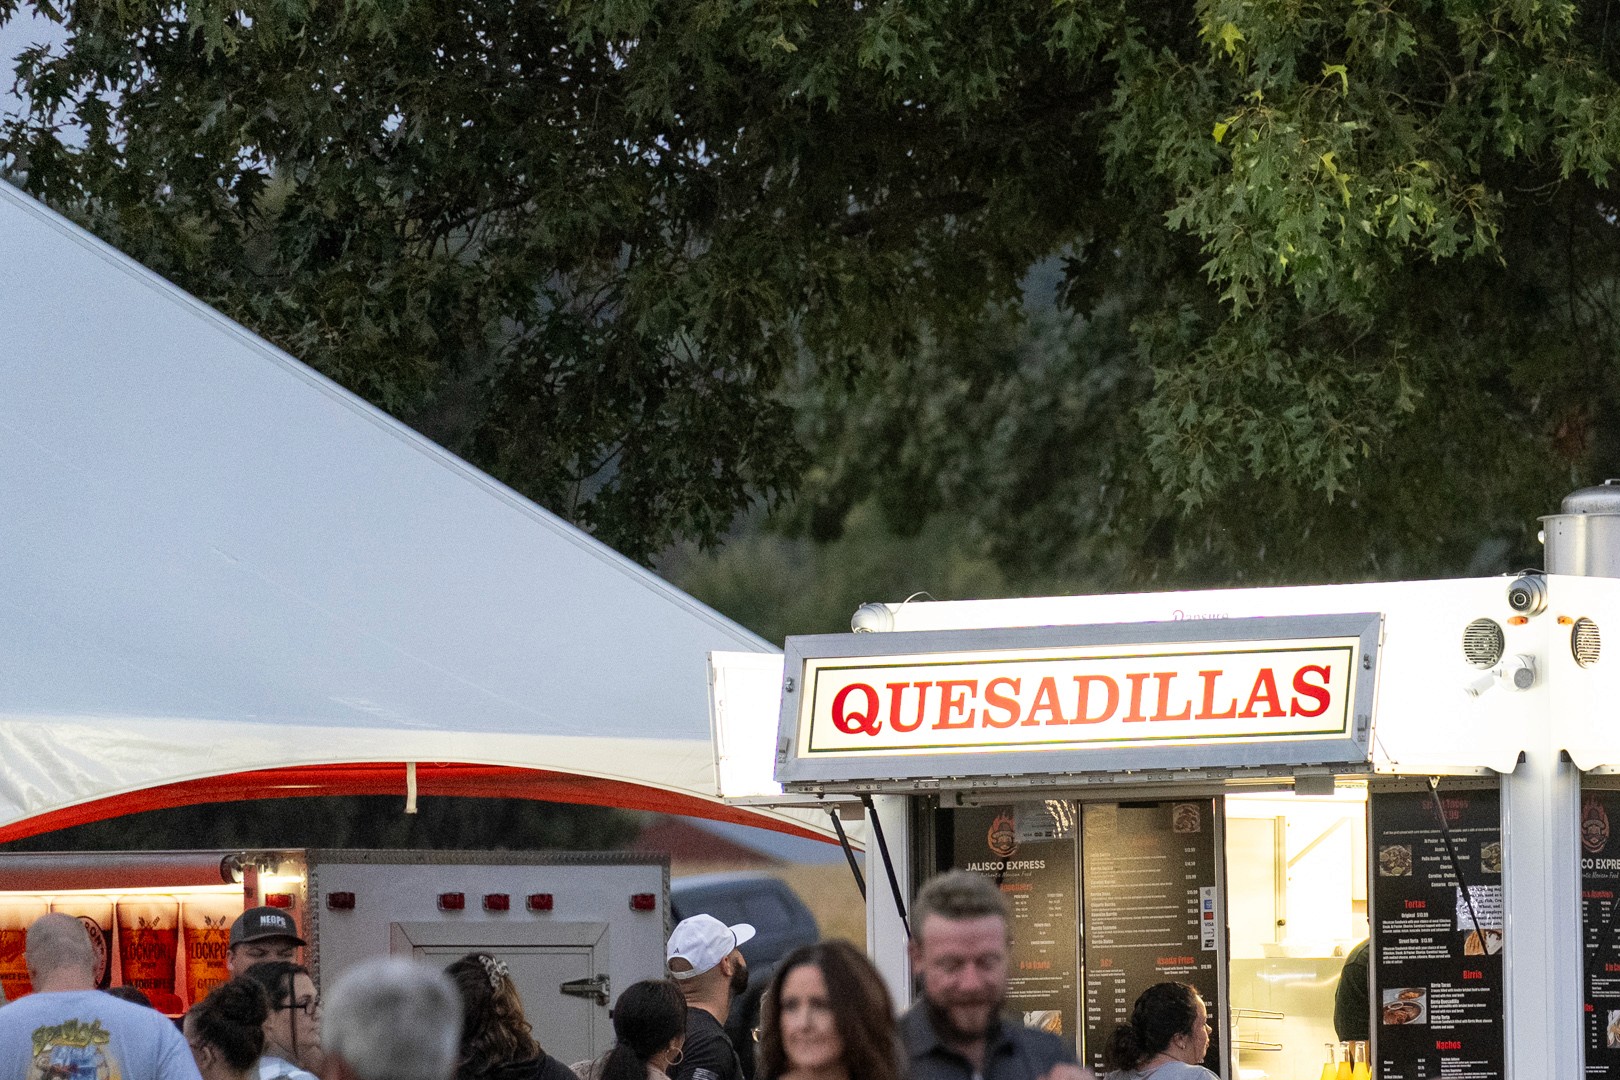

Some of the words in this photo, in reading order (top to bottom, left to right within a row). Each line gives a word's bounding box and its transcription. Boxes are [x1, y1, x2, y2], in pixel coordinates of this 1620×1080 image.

[831, 664, 1332, 736] QUESADILLAS
[965, 861, 1004, 871] JALISCO
[1006, 860, 1046, 870] EXPRESS
[1404, 900, 1426, 909] Tortas
[191, 942, 228, 960] LOCKPO
[1463, 970, 1483, 979] Birria
[1436, 1041, 1461, 1050] Nachos
